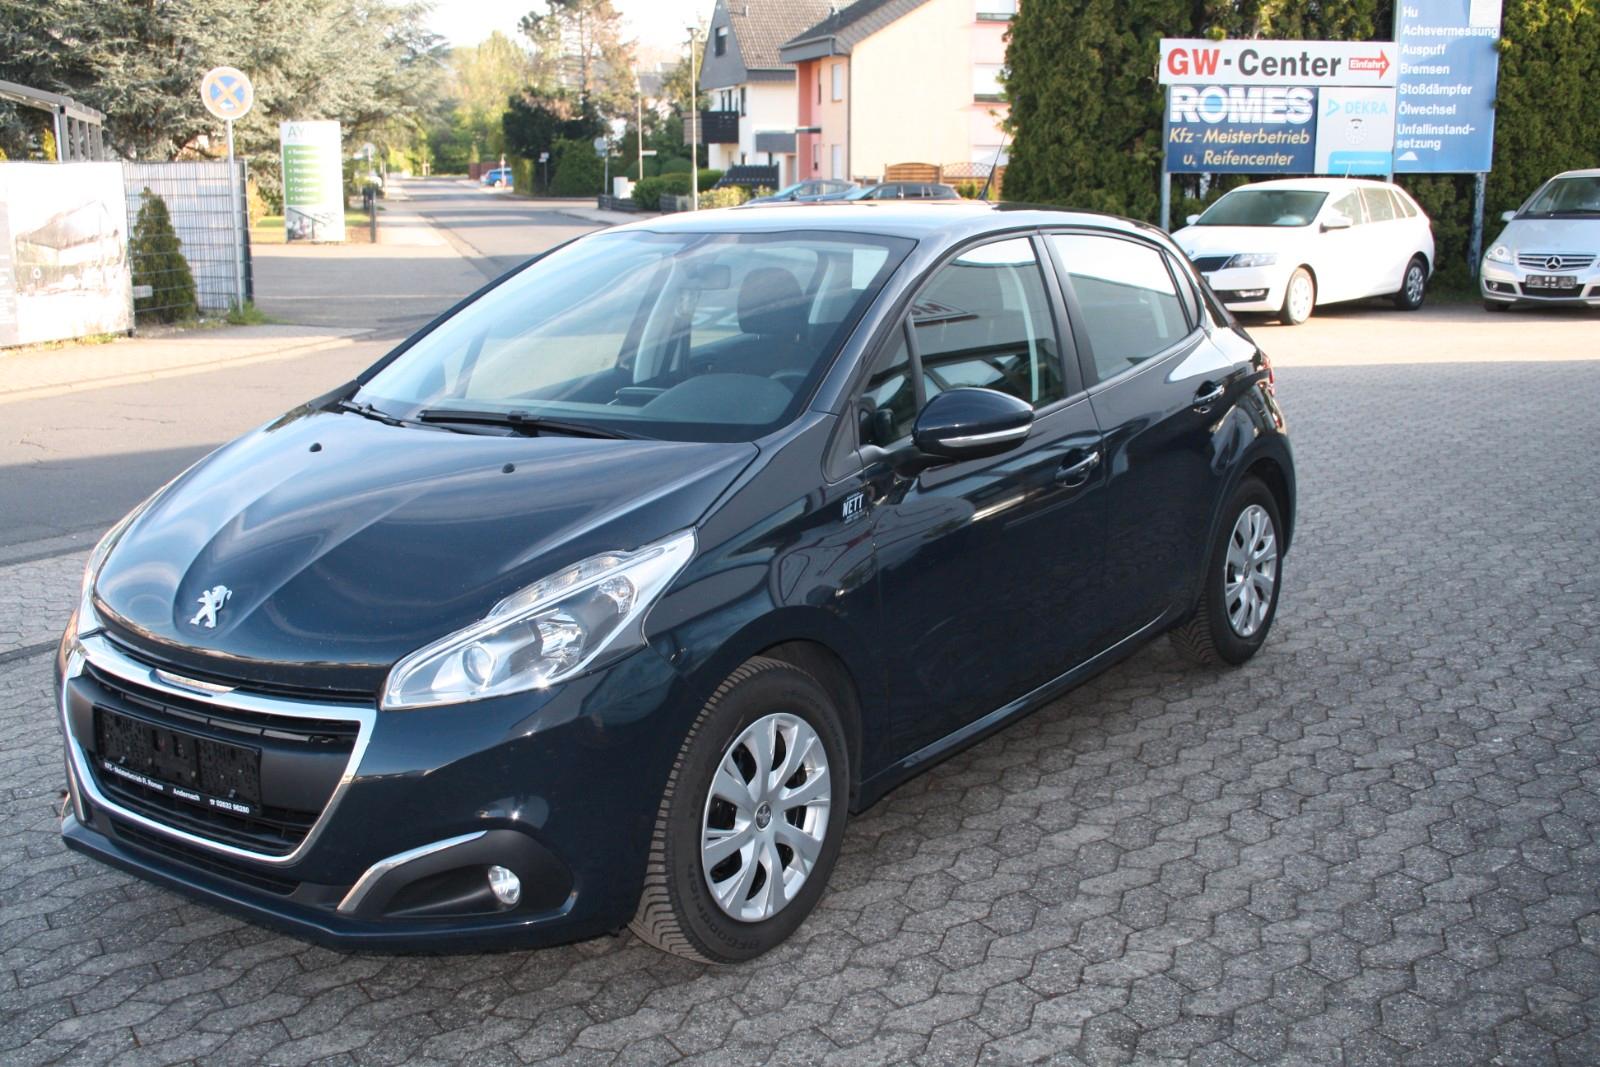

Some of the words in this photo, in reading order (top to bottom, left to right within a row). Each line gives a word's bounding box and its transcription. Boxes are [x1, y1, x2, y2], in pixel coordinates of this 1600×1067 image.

[1403, 6, 1418, 18] Hu
[1402, 24, 1498, 38] Achsvermessung
[1402, 43, 1446, 56] Auspuff
[1350, 59, 1387, 69] Einfahrt
[1400, 63, 1450, 75] Bremsen
[1400, 82, 1472, 96] Stoßdämpfer
[1169, 86, 1314, 124] ROMES
[1345, 101, 1388, 114] DEKRA
[1399, 100, 1456, 115] Ölwechsel
[1397, 123, 1476, 135] Unfallinstand-
[1397, 139, 1441, 151] setzung
[1183, 154, 1196, 166] u.
[1203, 150, 1294, 165] Reifencenter
